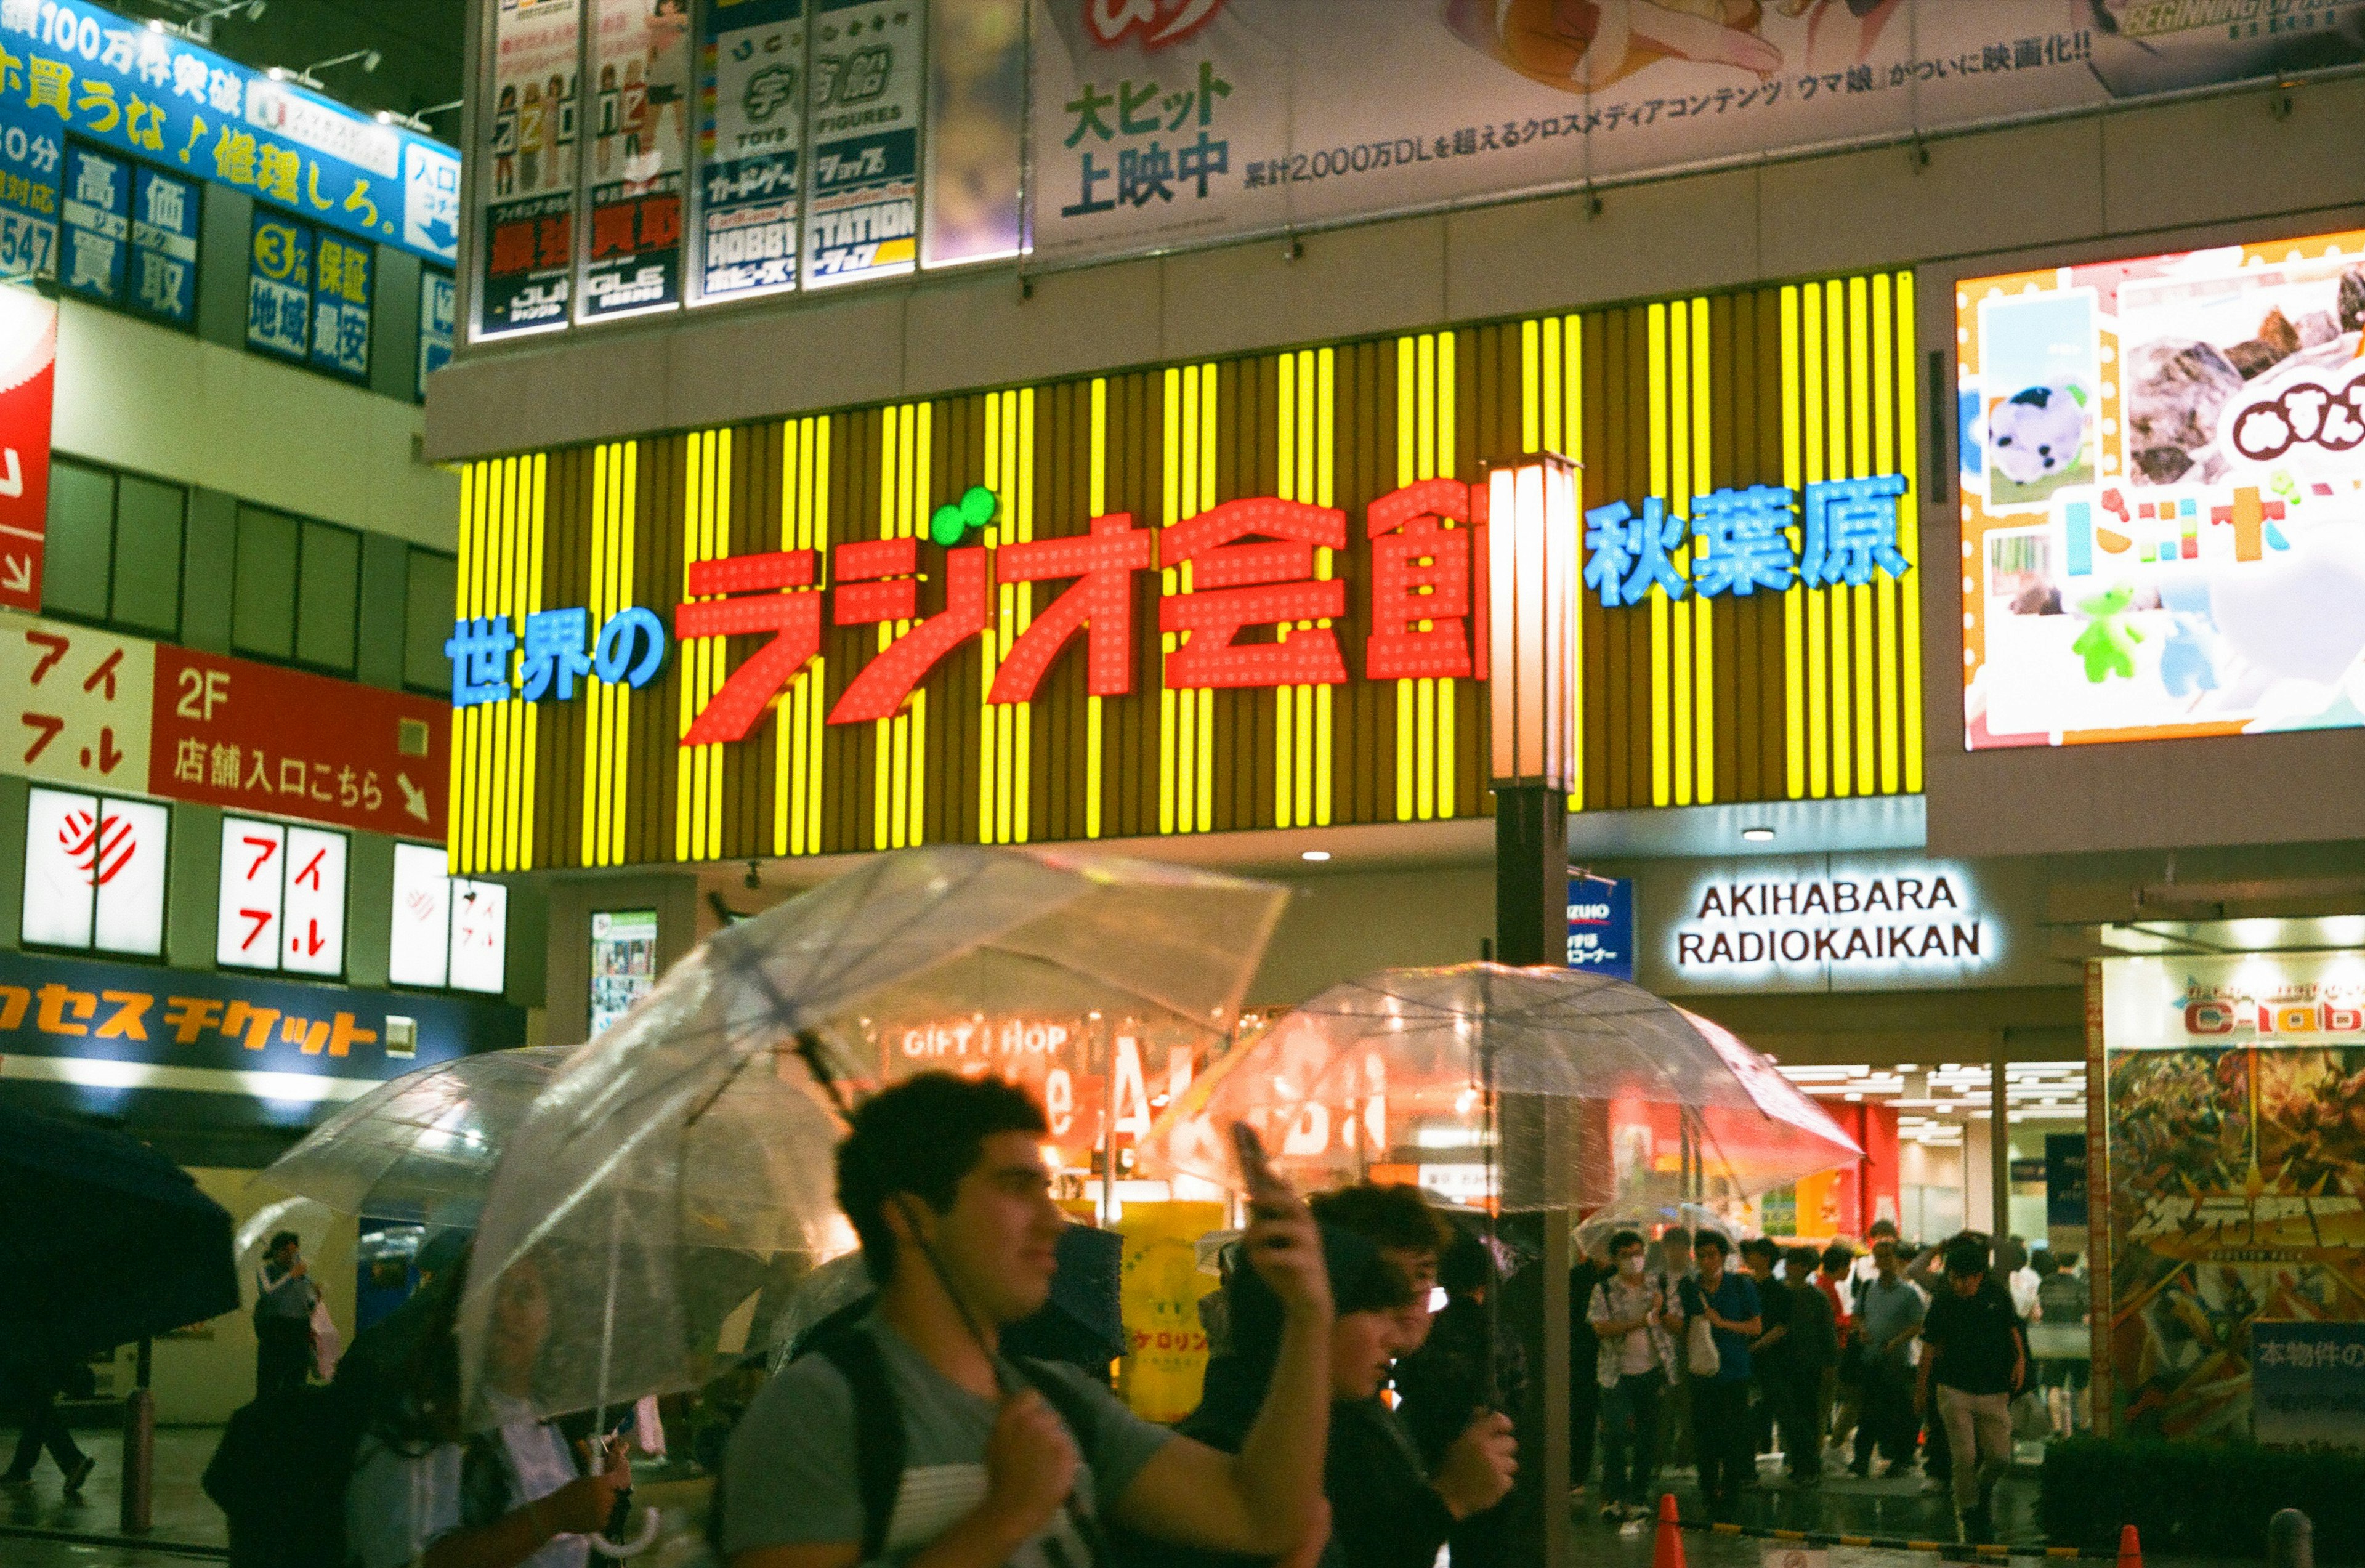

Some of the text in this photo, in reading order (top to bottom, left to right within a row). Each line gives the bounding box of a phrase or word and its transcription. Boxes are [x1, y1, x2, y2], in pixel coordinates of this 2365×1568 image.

[817, 105, 904, 134] FIGURES
[1064, 62, 1232, 148] 大ヒット
[0, 126, 59, 172] 0分
[1061, 132, 1229, 218] 上映中
[445, 607, 665, 708] 世界の
[1583, 473, 1909, 607] 秋葉原
[176, 668, 232, 721] 2F
[174, 738, 383, 811] 店舗入口こちら
[1698, 878, 1959, 919] AKIHABARA
[1678, 923, 1981, 965] RADIOKAIKAN
[903, 1027, 973, 1056] GIFT
